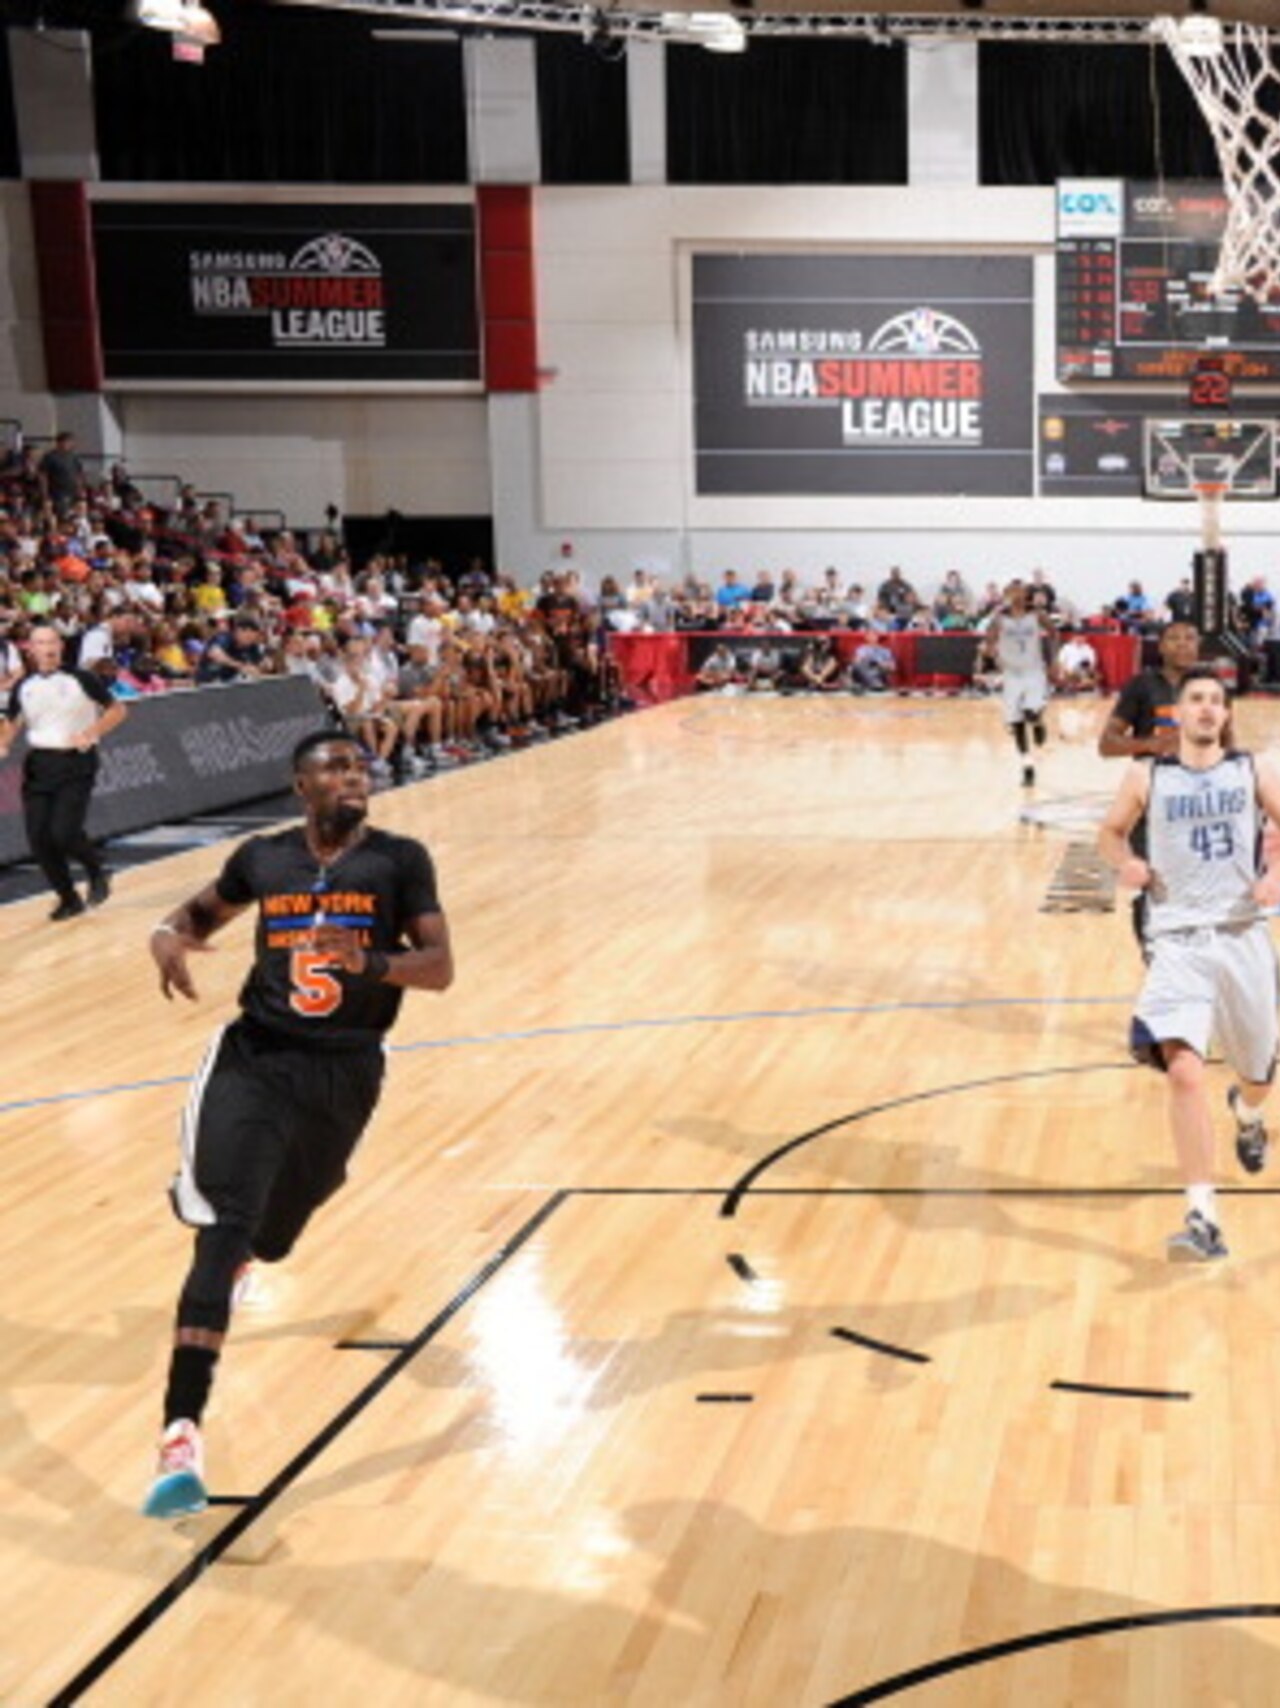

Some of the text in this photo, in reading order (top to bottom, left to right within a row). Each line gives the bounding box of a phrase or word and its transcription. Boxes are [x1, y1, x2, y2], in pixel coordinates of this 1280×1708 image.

[190, 251, 286, 269] SAMSUNG
[272, 309, 386, 339] LEAGUE
[745, 330, 862, 351] SAMSUNG
[842, 400, 983, 436] LEAGUE
[1164, 787, 1246, 822] DALLAS
[1190, 821, 1234, 862] 43
[263, 890, 376, 915] NEW YORK
[289, 950, 342, 1017] 5
